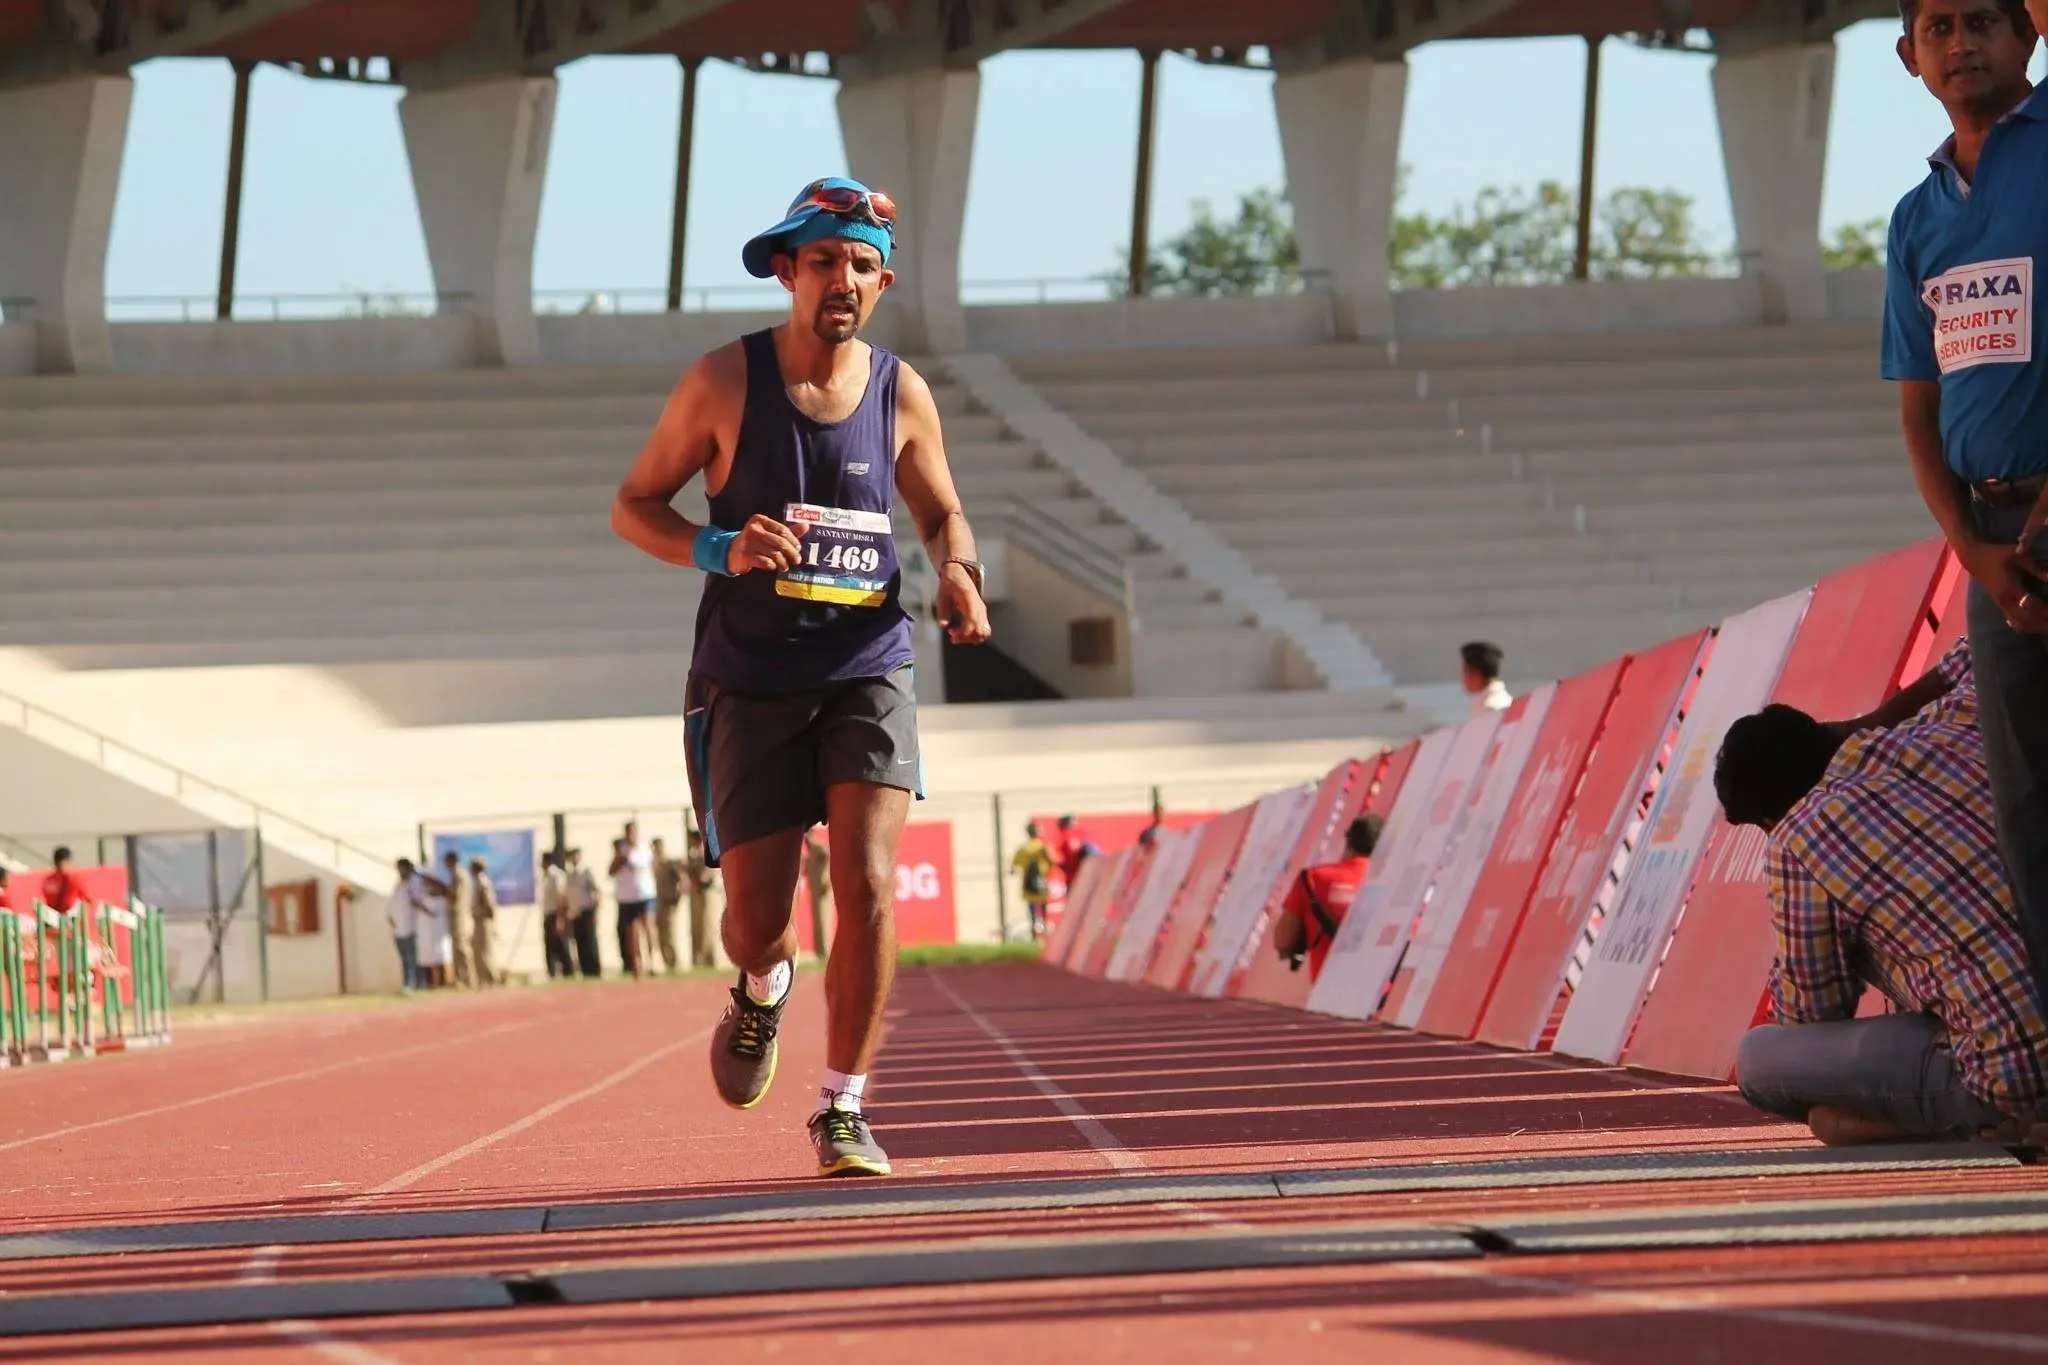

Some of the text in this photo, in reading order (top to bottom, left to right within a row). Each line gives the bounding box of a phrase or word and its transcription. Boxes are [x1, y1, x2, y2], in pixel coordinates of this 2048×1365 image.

[1946, 275, 2022, 304] RAXA
[1939, 308, 2019, 335] ECURITY
[1940, 333, 2016, 359] SERVICES
[816, 529, 874, 542] SANTANU MISRA
[807, 542, 879, 572] 1469
